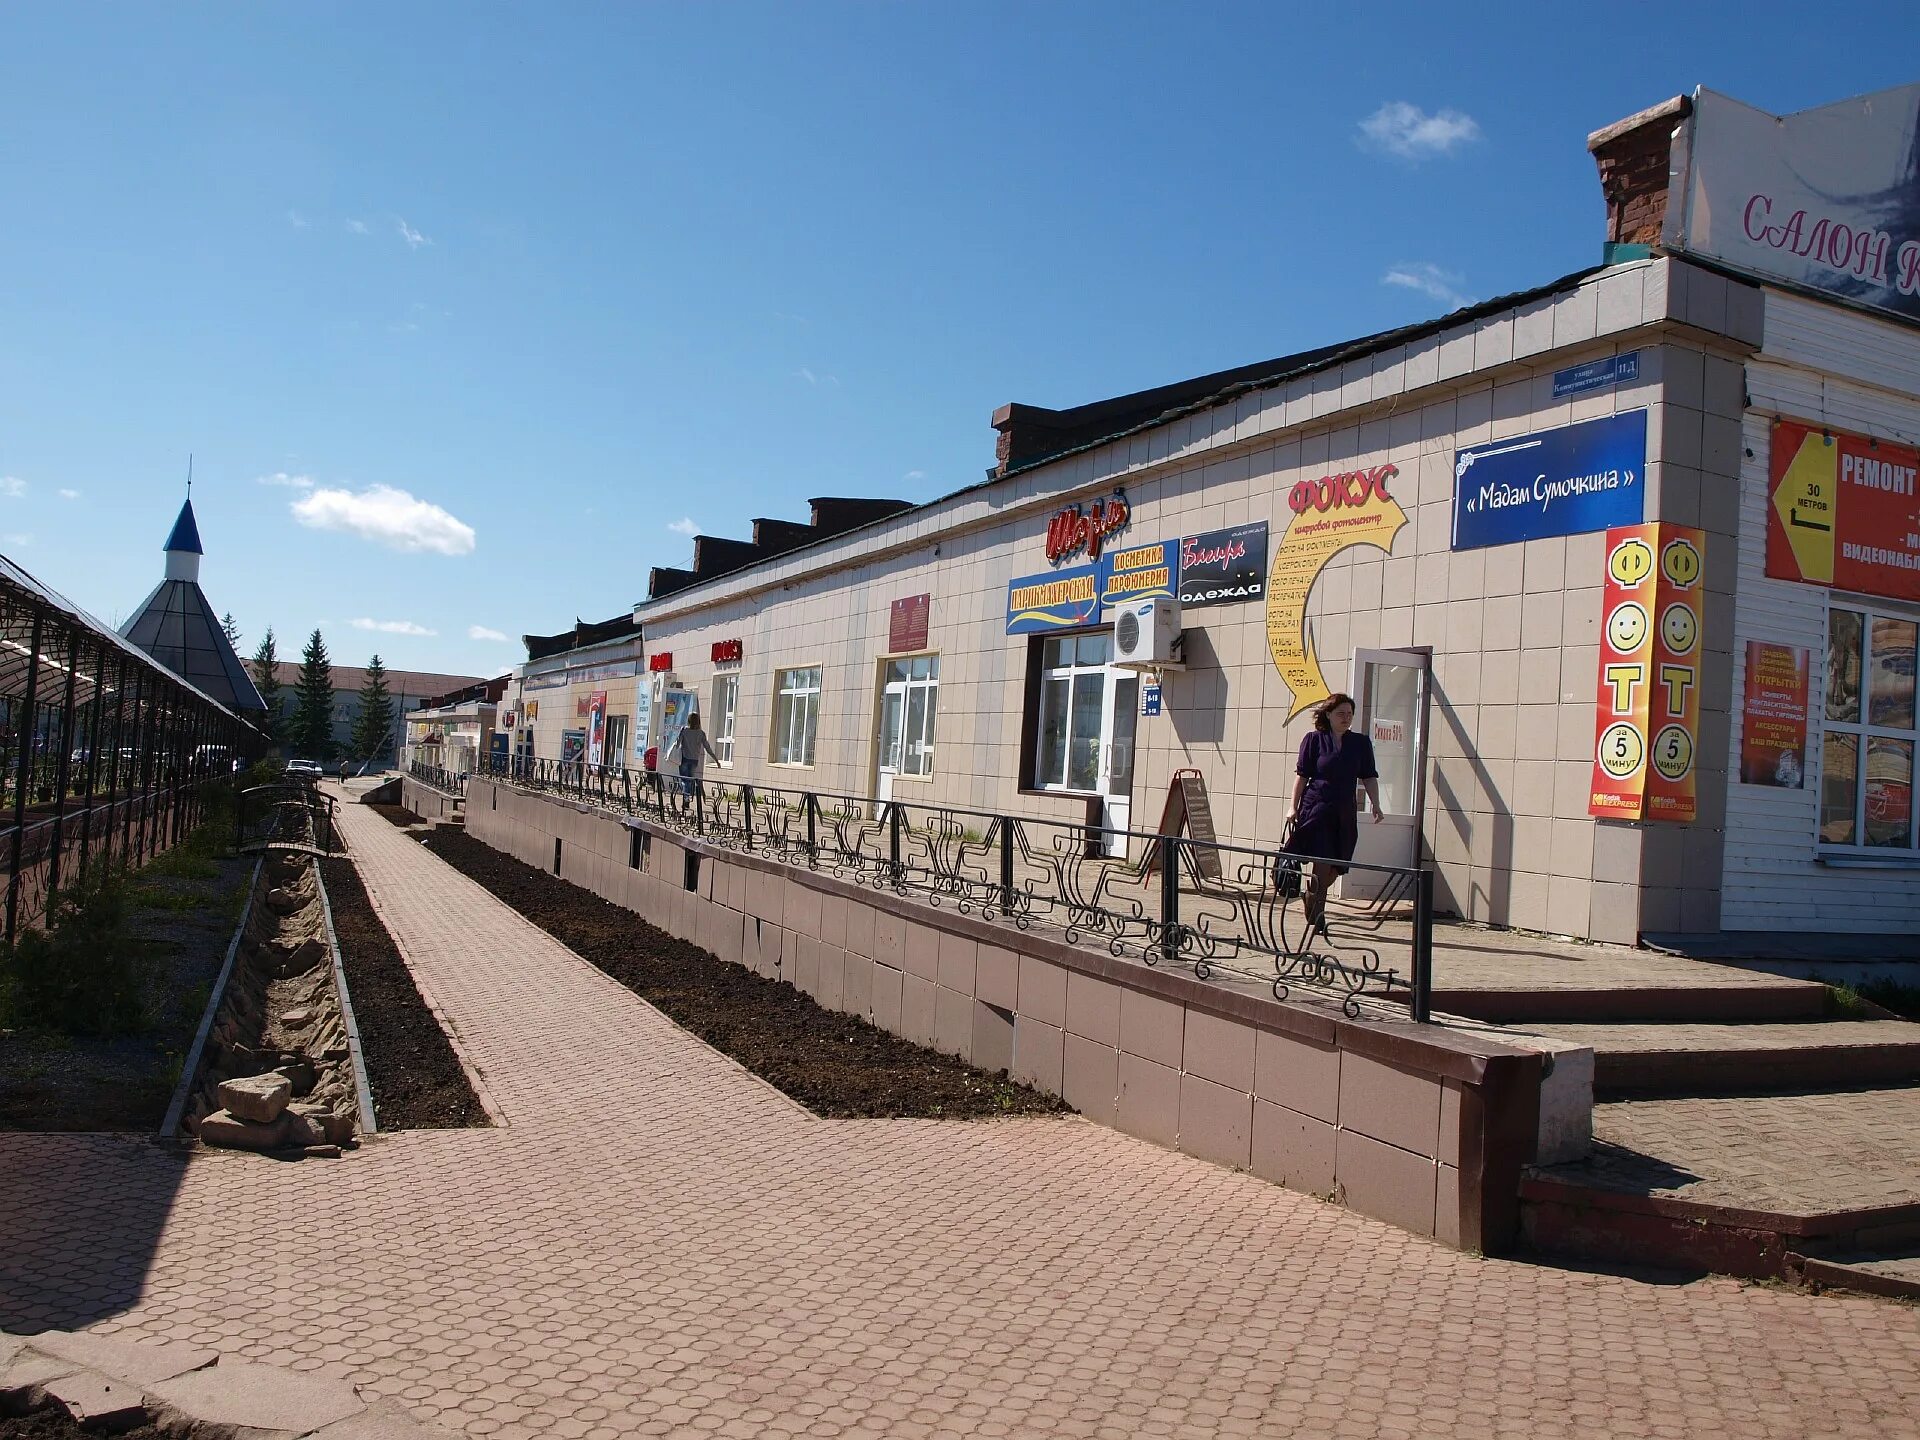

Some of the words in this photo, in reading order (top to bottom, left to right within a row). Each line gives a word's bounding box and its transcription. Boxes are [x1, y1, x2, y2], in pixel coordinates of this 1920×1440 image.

[1744, 194, 1889, 281] САЛОН
[1841, 453, 1917, 496] РЕМОНТ
[1288, 463, 1400, 515] ФОКУС
[1479, 482, 1530, 511] Мадам
[1533, 469, 1618, 513] Сумочкина
[1807, 483, 1820, 497] 30
[1797, 498, 1828, 511] МЕТРОВ
[1294, 519, 1331, 536] цифровой
[1332, 513, 1382, 532] фотоцентр
[1114, 545, 1164, 571] КОСМЕТИКА
[1108, 567, 1169, 593] ПАРФЮМЕРИЯ
[1011, 575, 1095, 611] ПАРИКМАХЕРСКАЯ
[1180, 583, 1262, 602] одежда
[1754, 674, 1801, 689] ОТКРЫТКИ
[1374, 723, 1392, 742] Скидка
[1755, 722, 1796, 733] АКСЕССУАРЫ
[1770, 732, 1780, 740] НА
[1615, 737, 1627, 758] 5
[1667, 739, 1679, 760] 5
[1750, 738, 1765, 746] ВАШ
[1766, 739, 1800, 750] ПРАЗДНИК
[1608, 800, 1640, 808] EXPRESS
